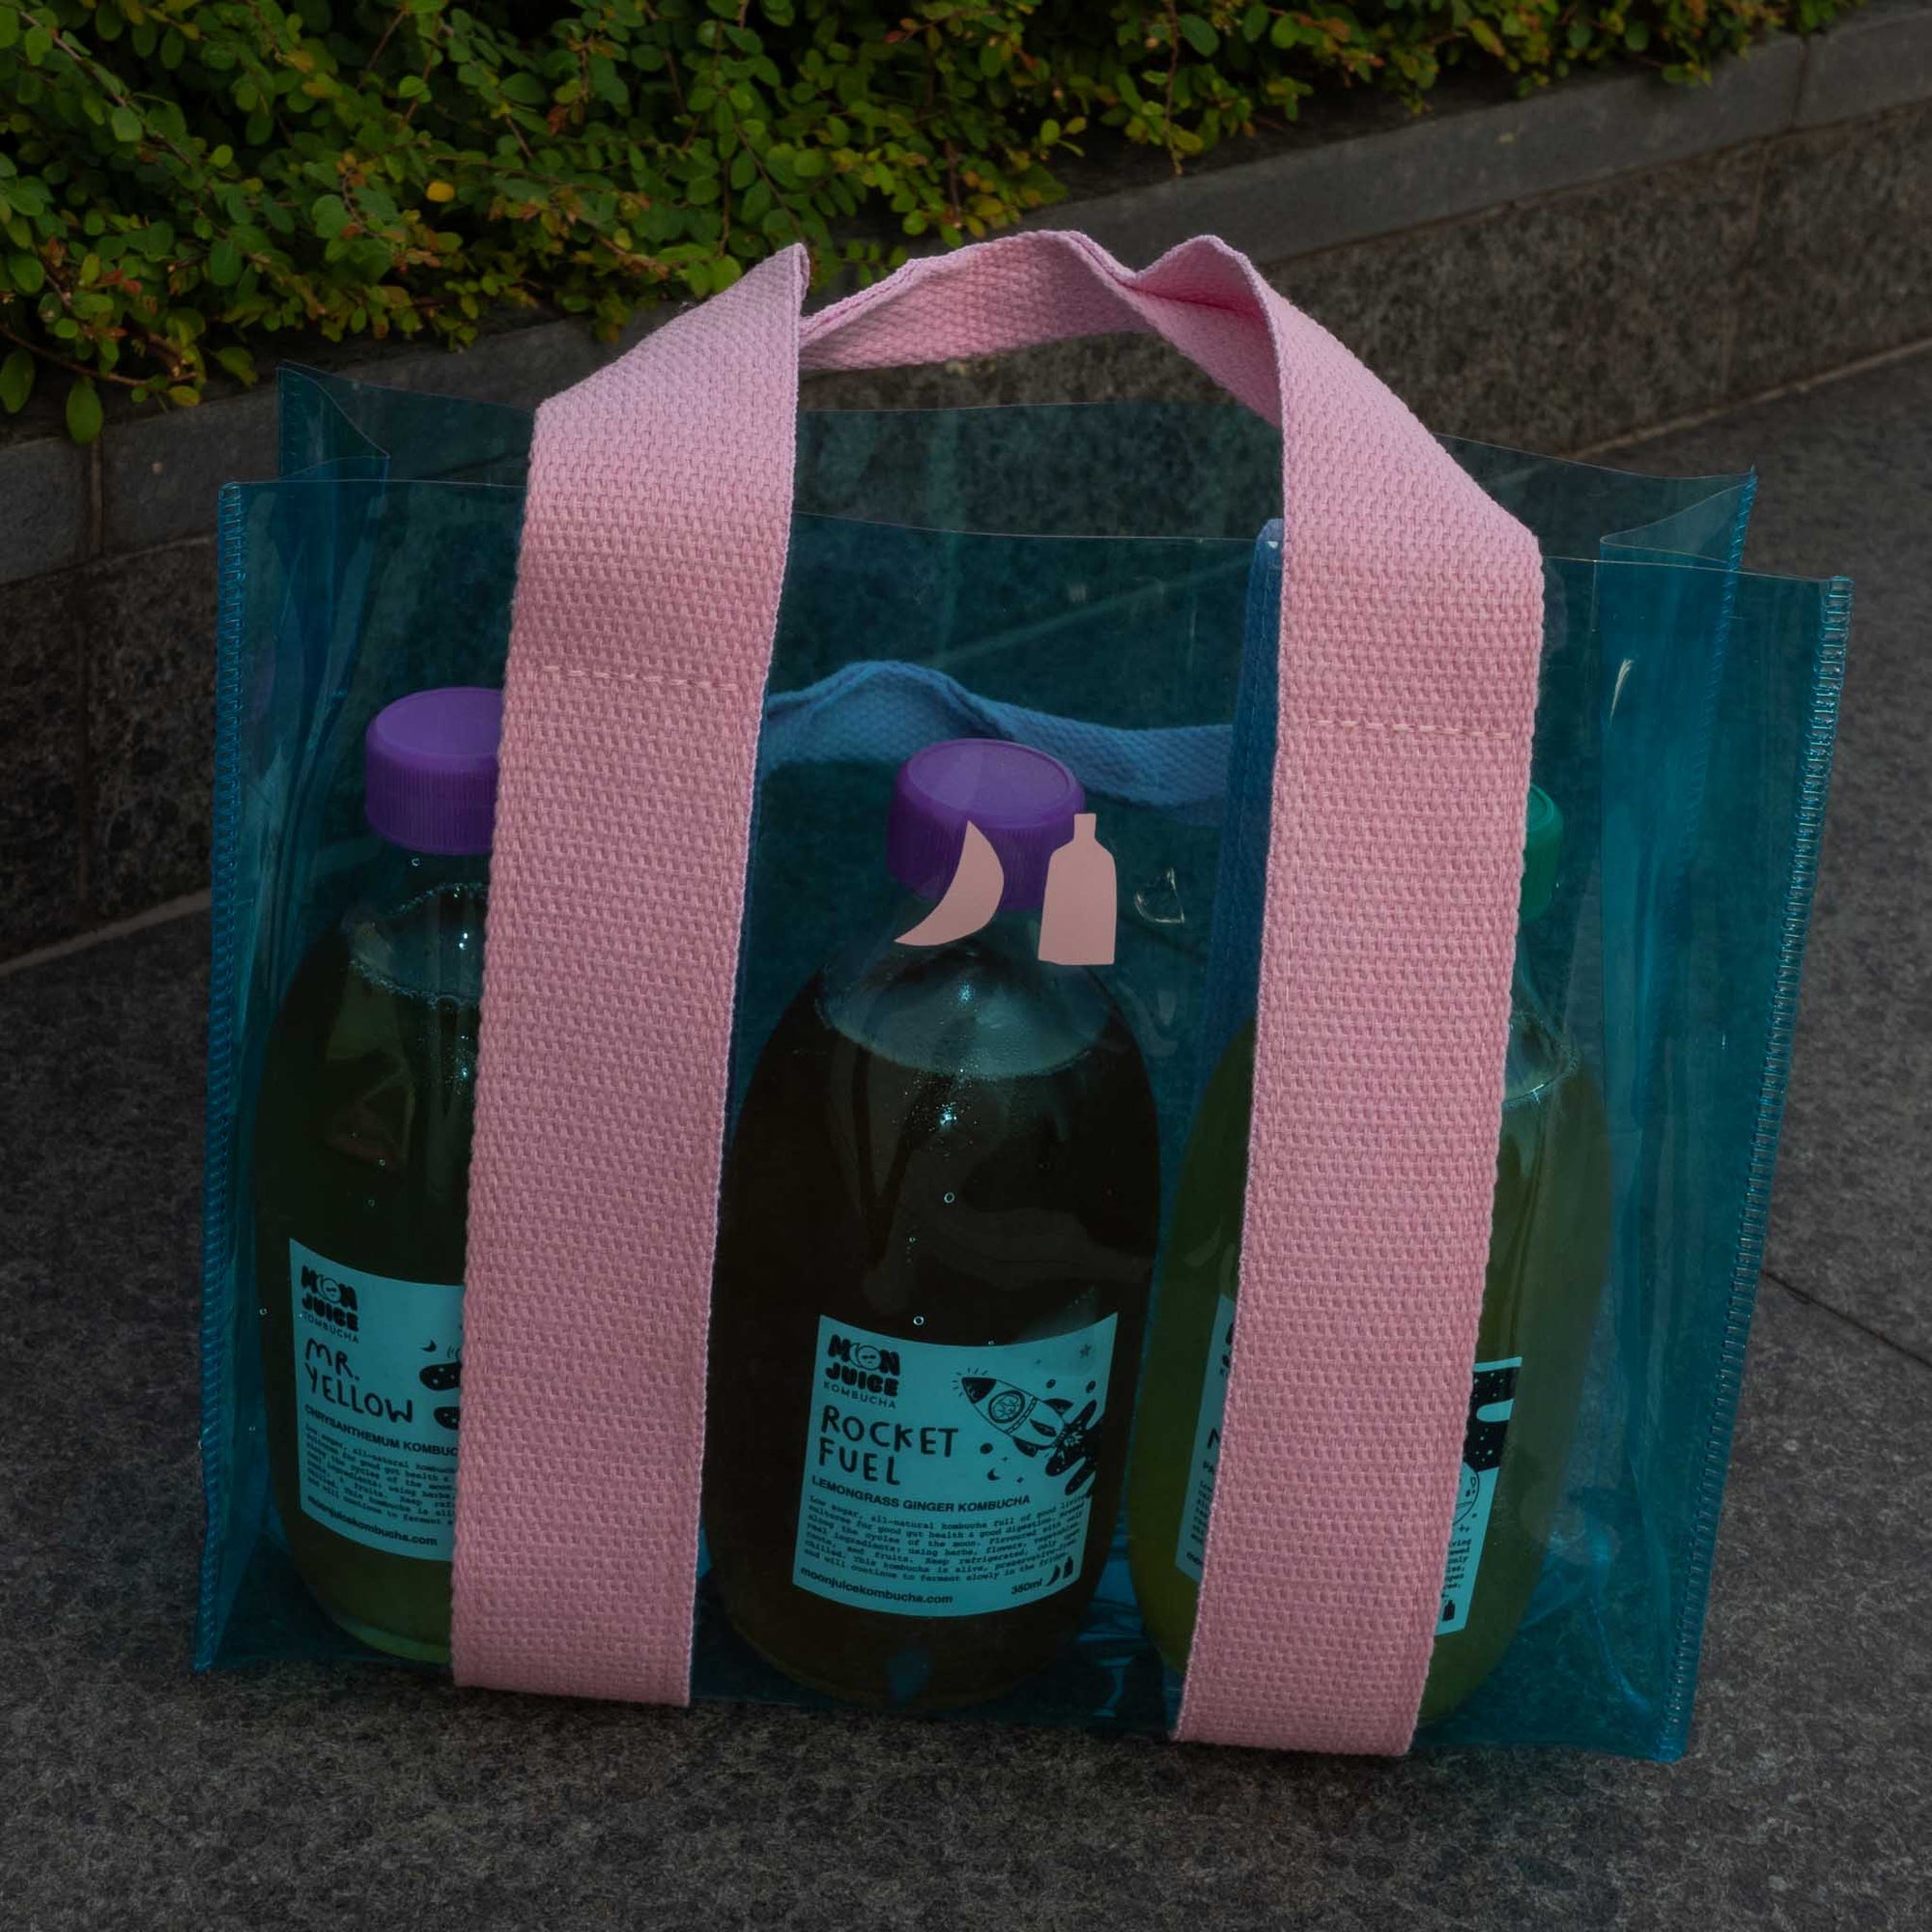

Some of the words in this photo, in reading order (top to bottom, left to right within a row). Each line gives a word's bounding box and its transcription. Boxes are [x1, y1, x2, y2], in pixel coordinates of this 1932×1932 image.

[300, 1311, 359, 1345] KOMBUCHA
[301, 1293, 359, 1332] JUICE
[305, 1338, 360, 1381] MR.
[304, 1362, 413, 1424] YELLOW
[823, 1380, 896, 1409] KOMBUCHA
[825, 1362, 899, 1398] JUICE
[304, 1404, 400, 1449] CHRYSANTHEMUM
[820, 1404, 959, 1459] ROCKET
[818, 1435, 901, 1486] FUEL
[810, 1474, 900, 1508] LEMONGRASS
[902, 1499, 955, 1513] GINGER
[957, 1494, 1031, 1513] KOMBUCHA
[840, 1525, 858, 1535] the
[865, 1532, 900, 1545] cycles
[927, 1538, 946, 1548] the
[870, 1515, 934, 1530] all-natural
[941, 1521, 987, 1530] kombucha
[993, 1517, 1014, 1527] full
[877, 1526, 902, 1535] good
[906, 1530, 924, 1539] gut
[928, 1529, 964, 1540] health
[979, 1527, 1003, 1538] good
[800, 1566, 954, 1605] moonjuicekombucha.com
[850, 1564, 898, 1578] continue
[921, 1574, 959, 1582] ferment
[965, 1571, 1001, 1581] slowly
[884, 1561, 930, 1573] kombucha
